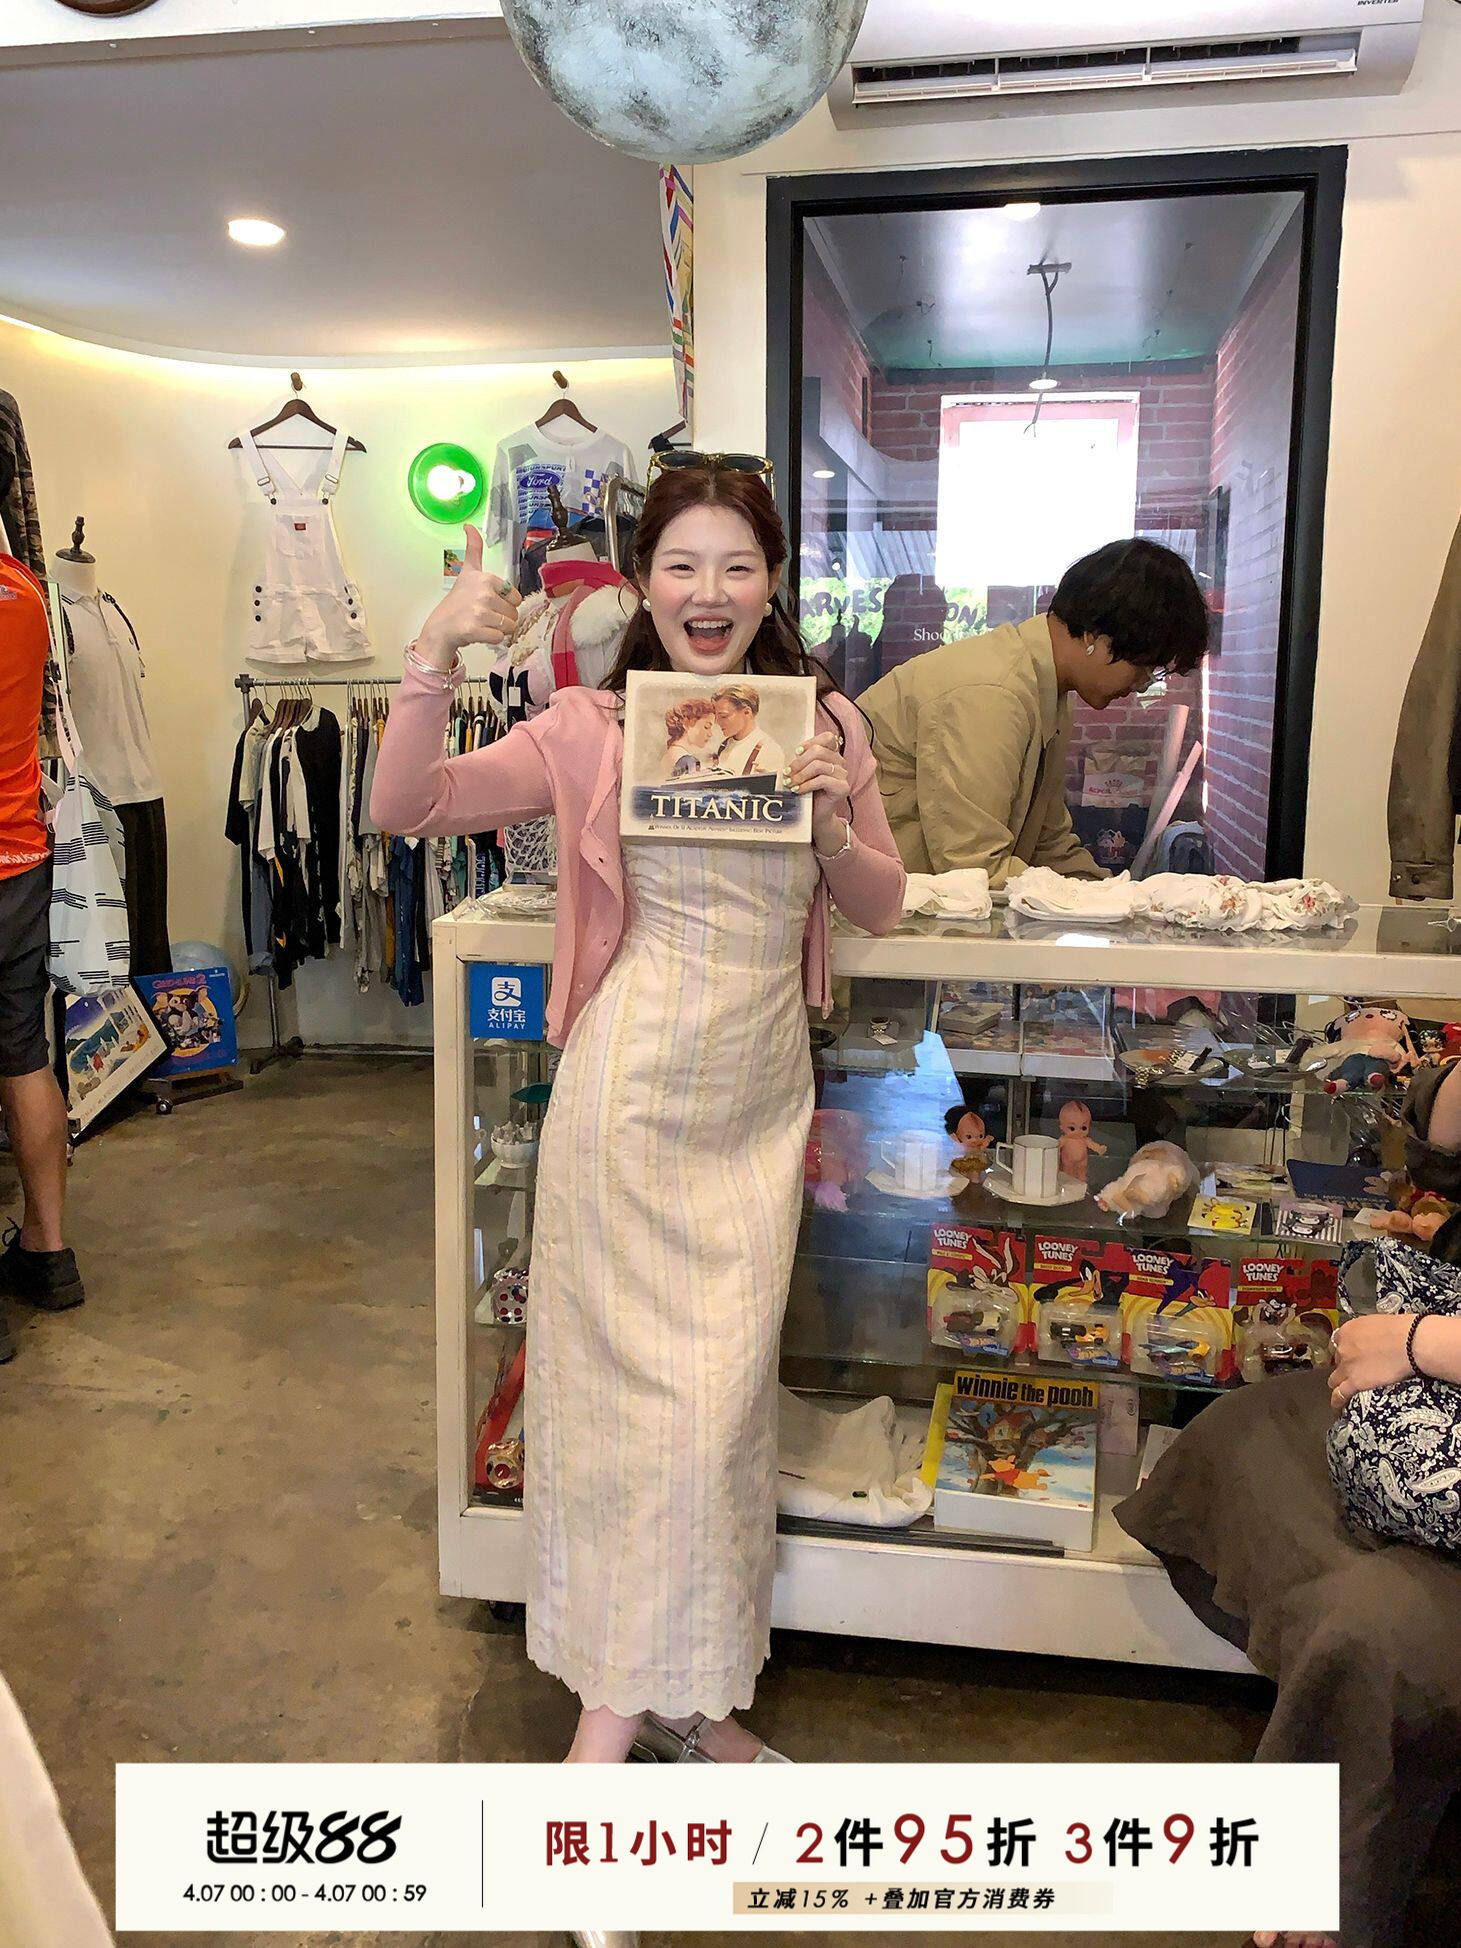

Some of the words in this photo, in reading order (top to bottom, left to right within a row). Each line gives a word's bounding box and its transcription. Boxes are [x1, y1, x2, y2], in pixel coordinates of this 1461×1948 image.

[526, 476, 552, 488] Ford
[651, 794, 784, 823] TITANIC
[487, 1008, 526, 1023] 支付宝
[488, 1022, 526, 1030] ALIPAY
[934, 1228, 973, 1242] LOONEY
[938, 1237, 968, 1249] TUNES
[1038, 1241, 1079, 1253] LOONEY
[1042, 1250, 1074, 1262] TUNES
[1132, 1254, 1174, 1267] LOONEY
[1136, 1262, 1170, 1275] TUNES
[1242, 1263, 1284, 1274] LOONEY
[1246, 1272, 1279, 1283] TUNES
[956, 1374, 1019, 1400] winnie
[1021, 1384, 1045, 1403] the
[1047, 1385, 1094, 1407] pooh
